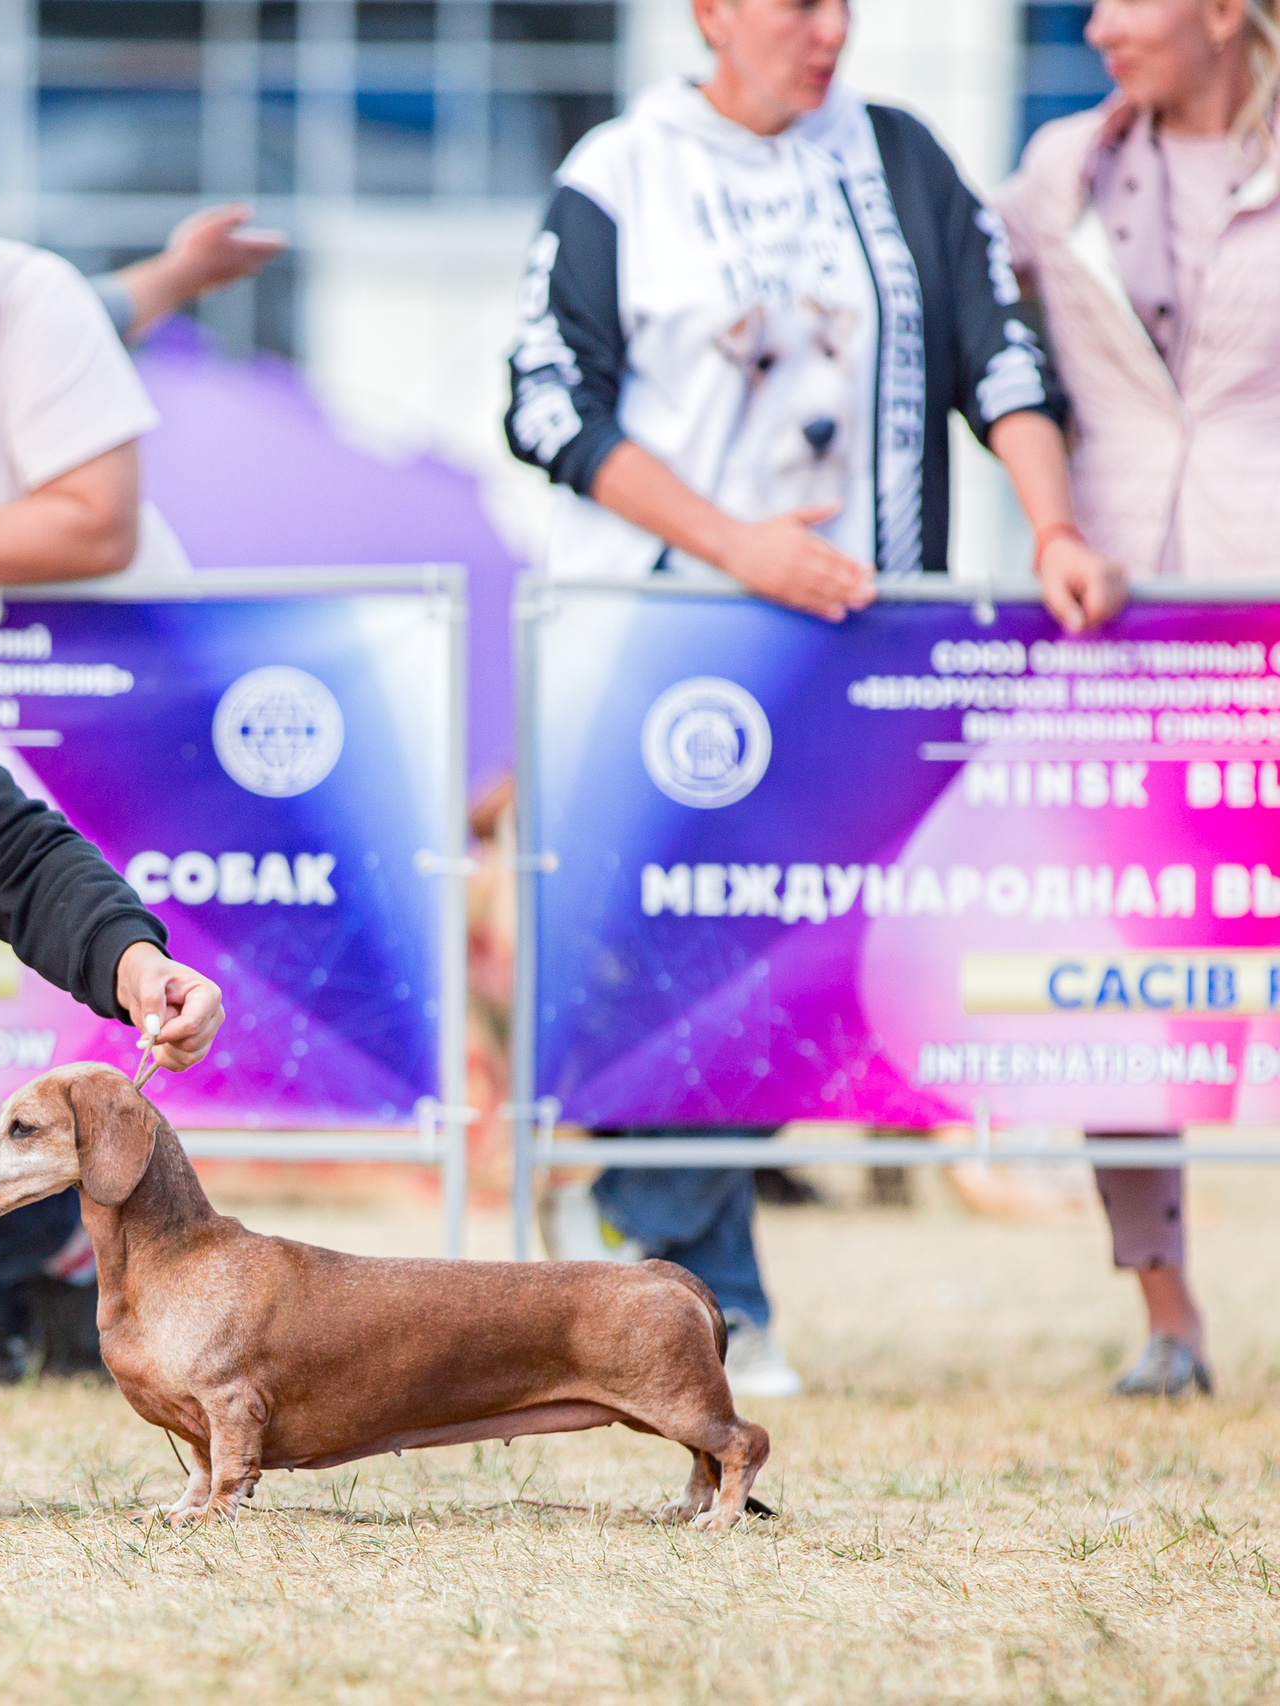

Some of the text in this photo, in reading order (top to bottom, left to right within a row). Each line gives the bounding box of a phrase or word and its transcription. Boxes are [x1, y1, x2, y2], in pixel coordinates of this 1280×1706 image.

[964, 760, 1149, 809] MINSK
[124, 850, 338, 906] СОБАК
[641, 862, 1197, 924] МЕЖДУНАРОДНАЯ
[1048, 963, 1237, 1011] CACIB
[919, 1040, 1238, 1086] INTERNATIONAL
